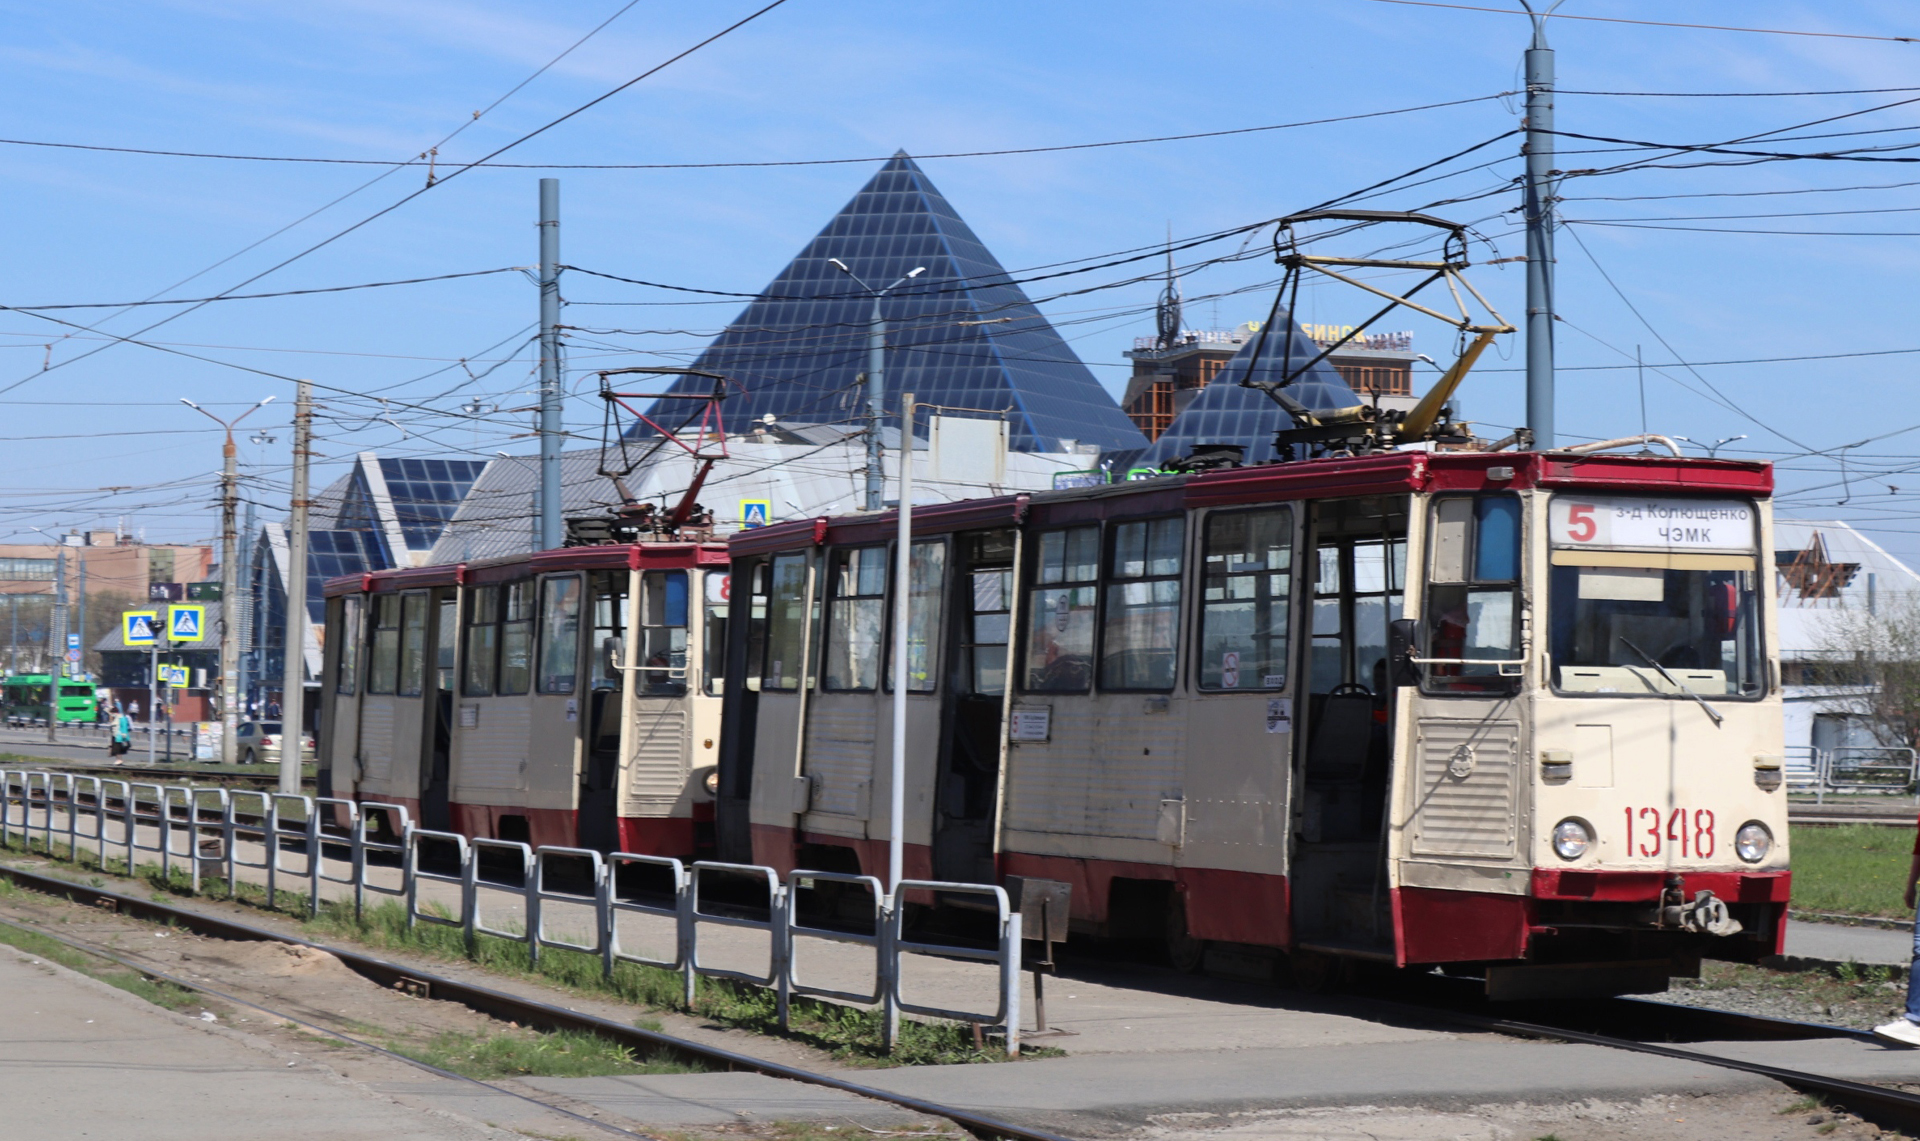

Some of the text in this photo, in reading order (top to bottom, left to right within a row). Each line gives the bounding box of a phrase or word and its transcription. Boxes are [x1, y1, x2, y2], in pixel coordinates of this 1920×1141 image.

[1567, 504, 1597, 542] 5
[1616, 503, 1749, 521] з-д Колющенко
[1658, 526, 1712, 543] ЧЭМК
[1624, 806, 1715, 859] 1348
